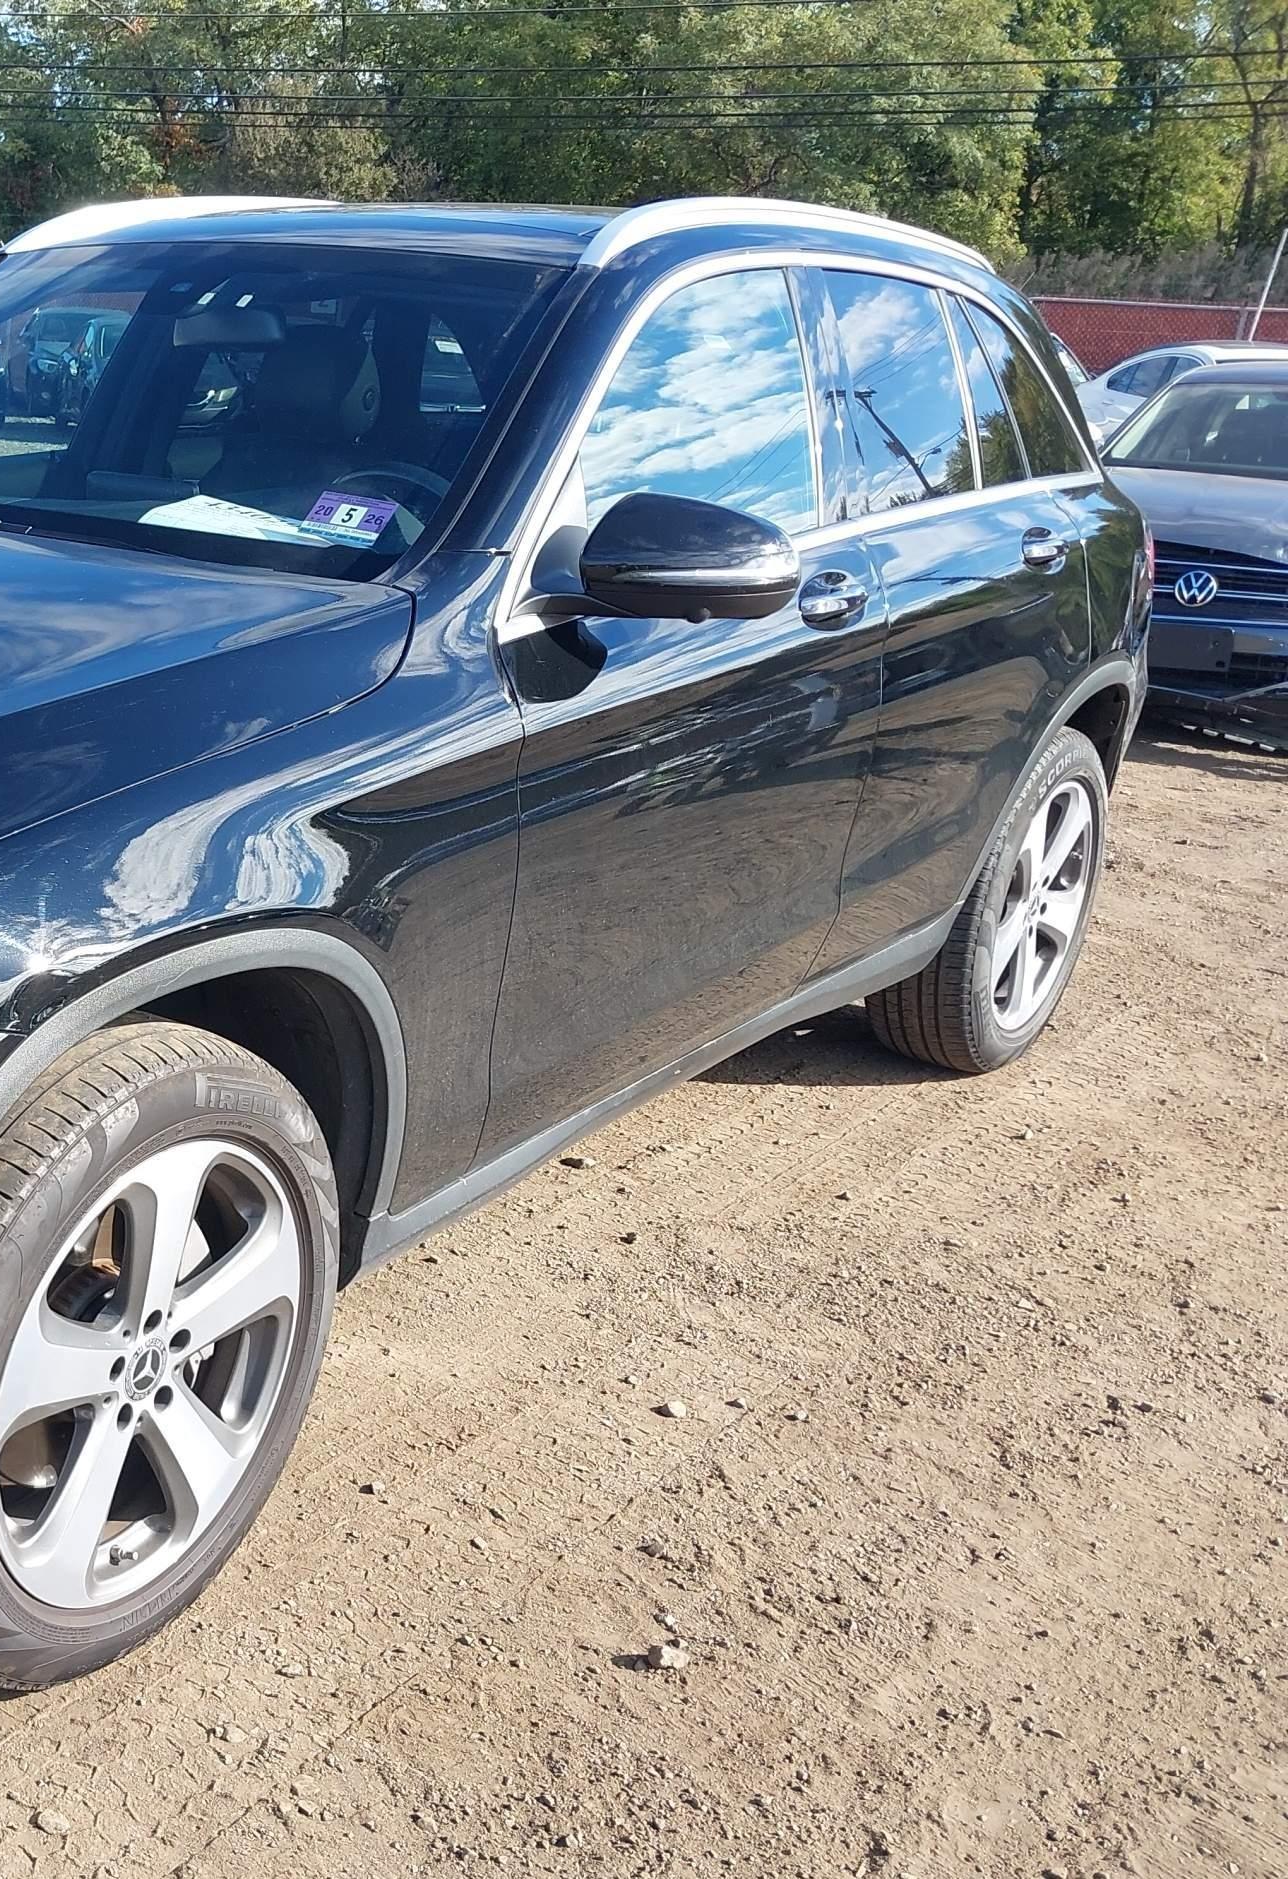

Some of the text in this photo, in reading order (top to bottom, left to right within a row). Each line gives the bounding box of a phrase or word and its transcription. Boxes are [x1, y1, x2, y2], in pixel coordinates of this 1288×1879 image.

[314, 505, 334, 516] 20
[341, 508, 358, 523] 5
[364, 514, 385, 526] 26
